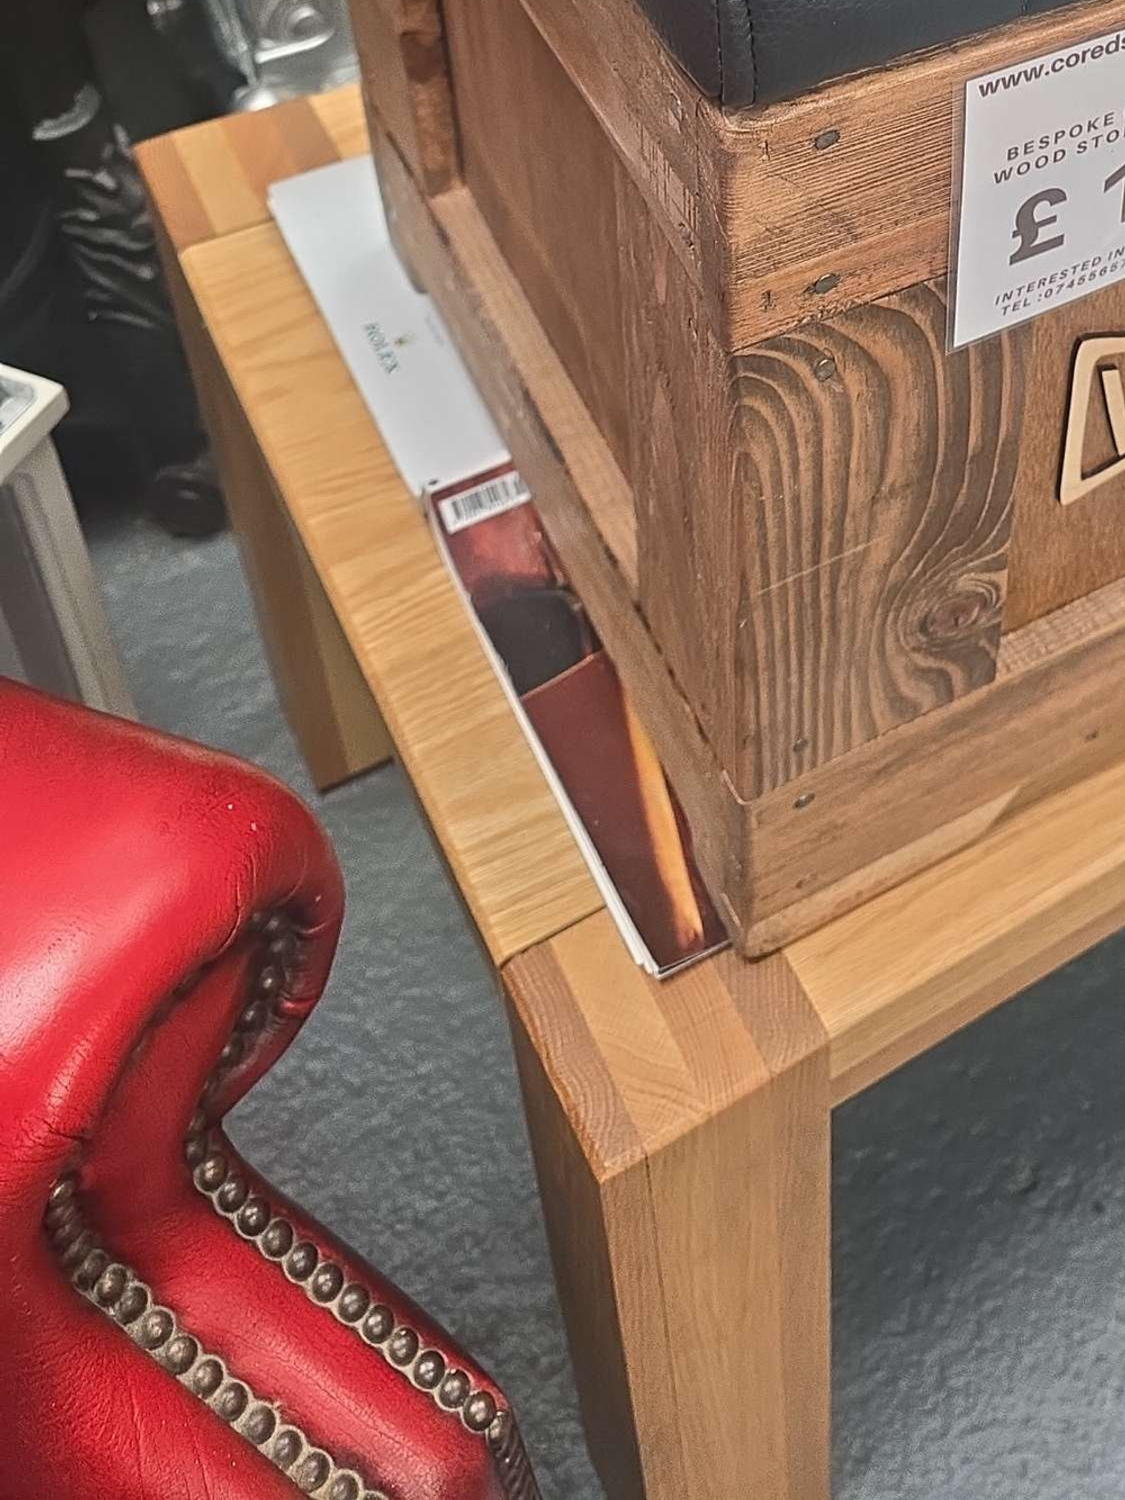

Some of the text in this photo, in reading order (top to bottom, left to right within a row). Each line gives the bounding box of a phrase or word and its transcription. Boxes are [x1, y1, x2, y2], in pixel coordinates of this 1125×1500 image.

[1006, 111, 1116, 162] BESPOKE
[993, 148, 1067, 185] WOOD
[995, 255, 1102, 306] INTERESTED
[1108, 245, 1125, 261] IN
